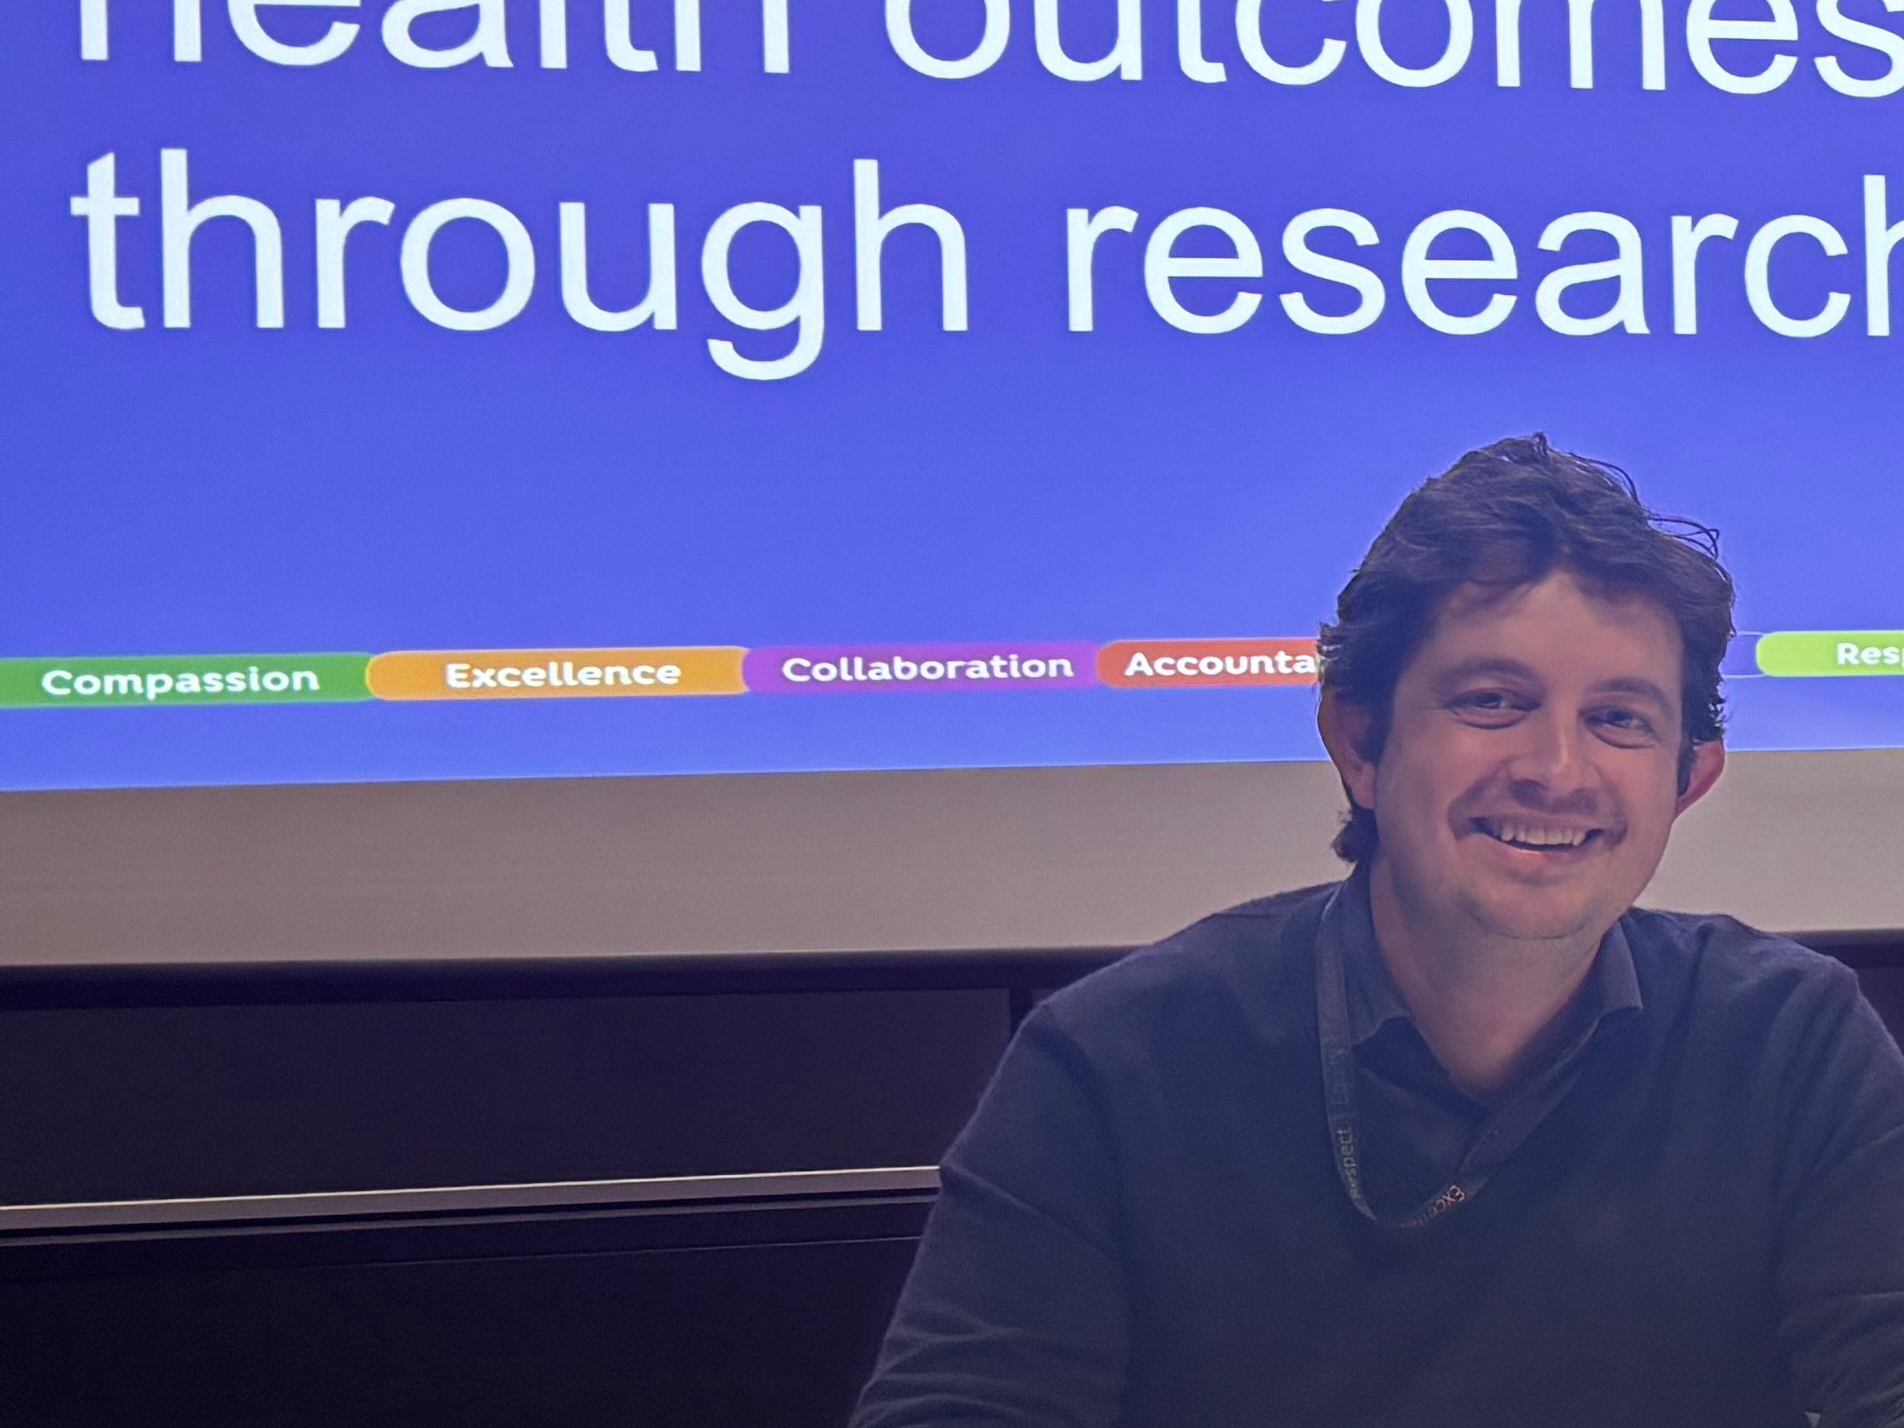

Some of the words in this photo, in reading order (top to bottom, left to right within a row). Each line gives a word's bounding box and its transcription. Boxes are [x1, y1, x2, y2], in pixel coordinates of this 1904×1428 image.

[71, 147, 967, 382] through
[40, 663, 321, 700] Compassion
[445, 658, 682, 691] Excellence
[781, 650, 1074, 686] Collaboration
